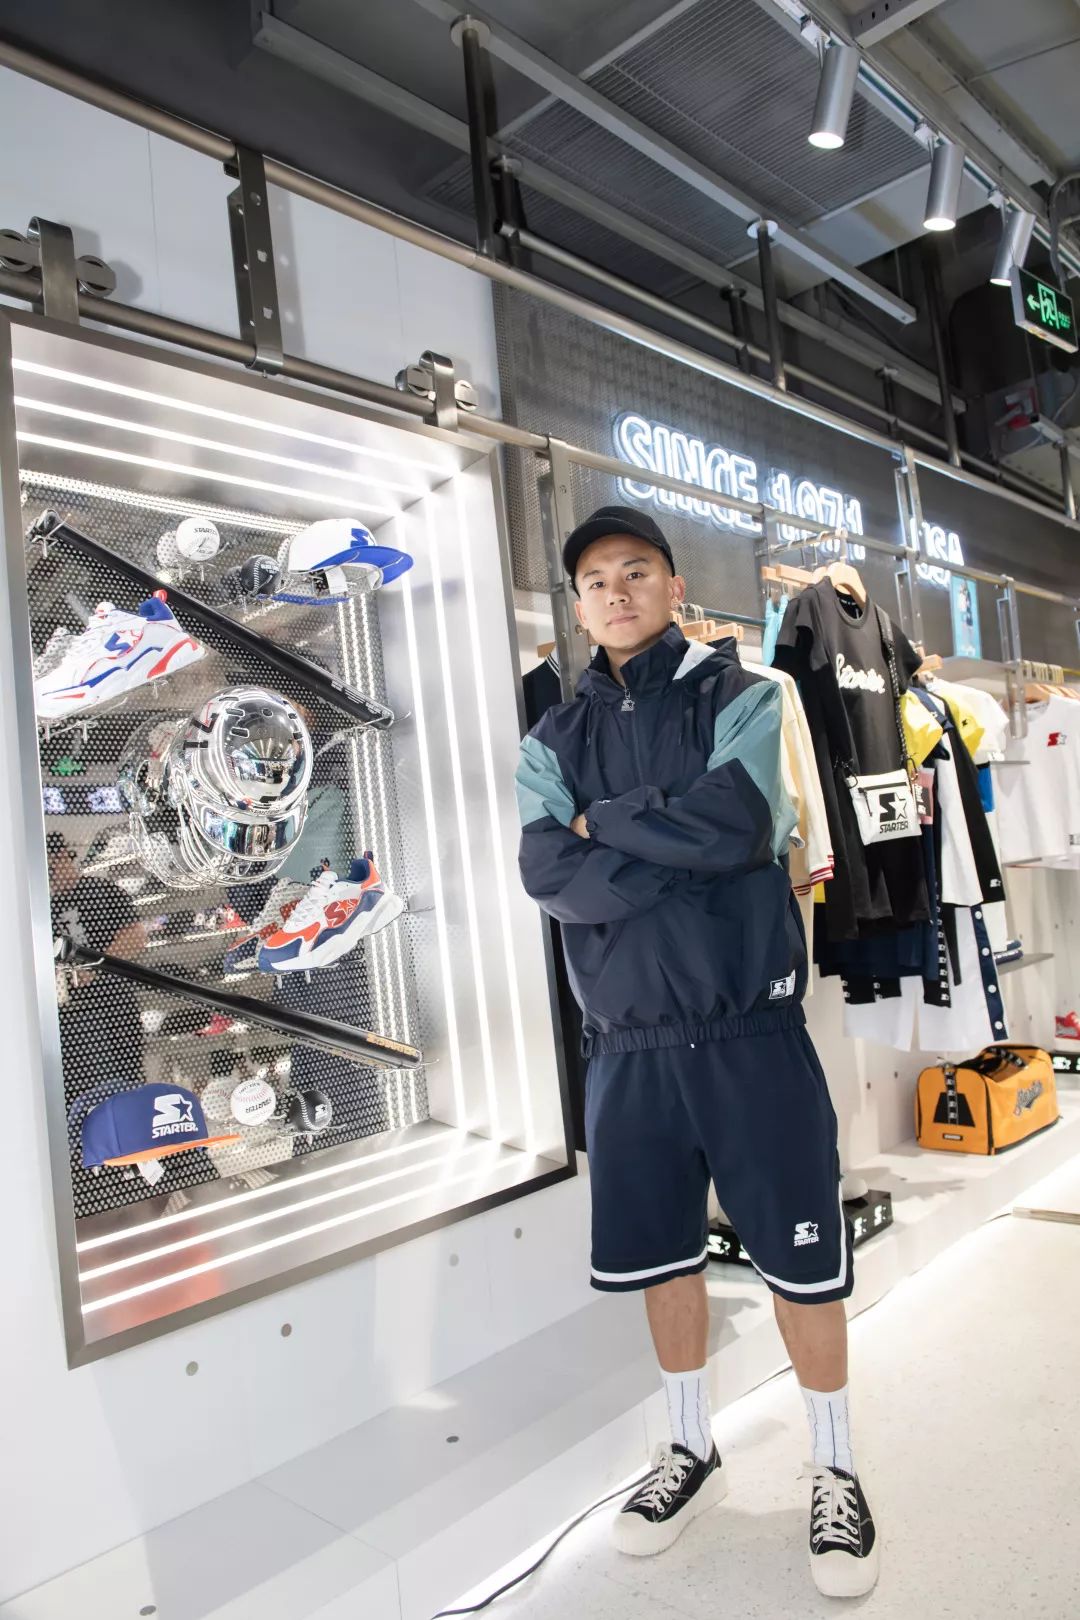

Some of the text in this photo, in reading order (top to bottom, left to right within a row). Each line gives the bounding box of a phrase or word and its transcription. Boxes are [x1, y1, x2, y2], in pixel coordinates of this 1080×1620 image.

[618, 413, 763, 534] SINCE
[879, 820, 909, 834] STARTER
[151, 1121, 199, 1139] STARTER
[793, 1236, 820, 1247] STARTER
